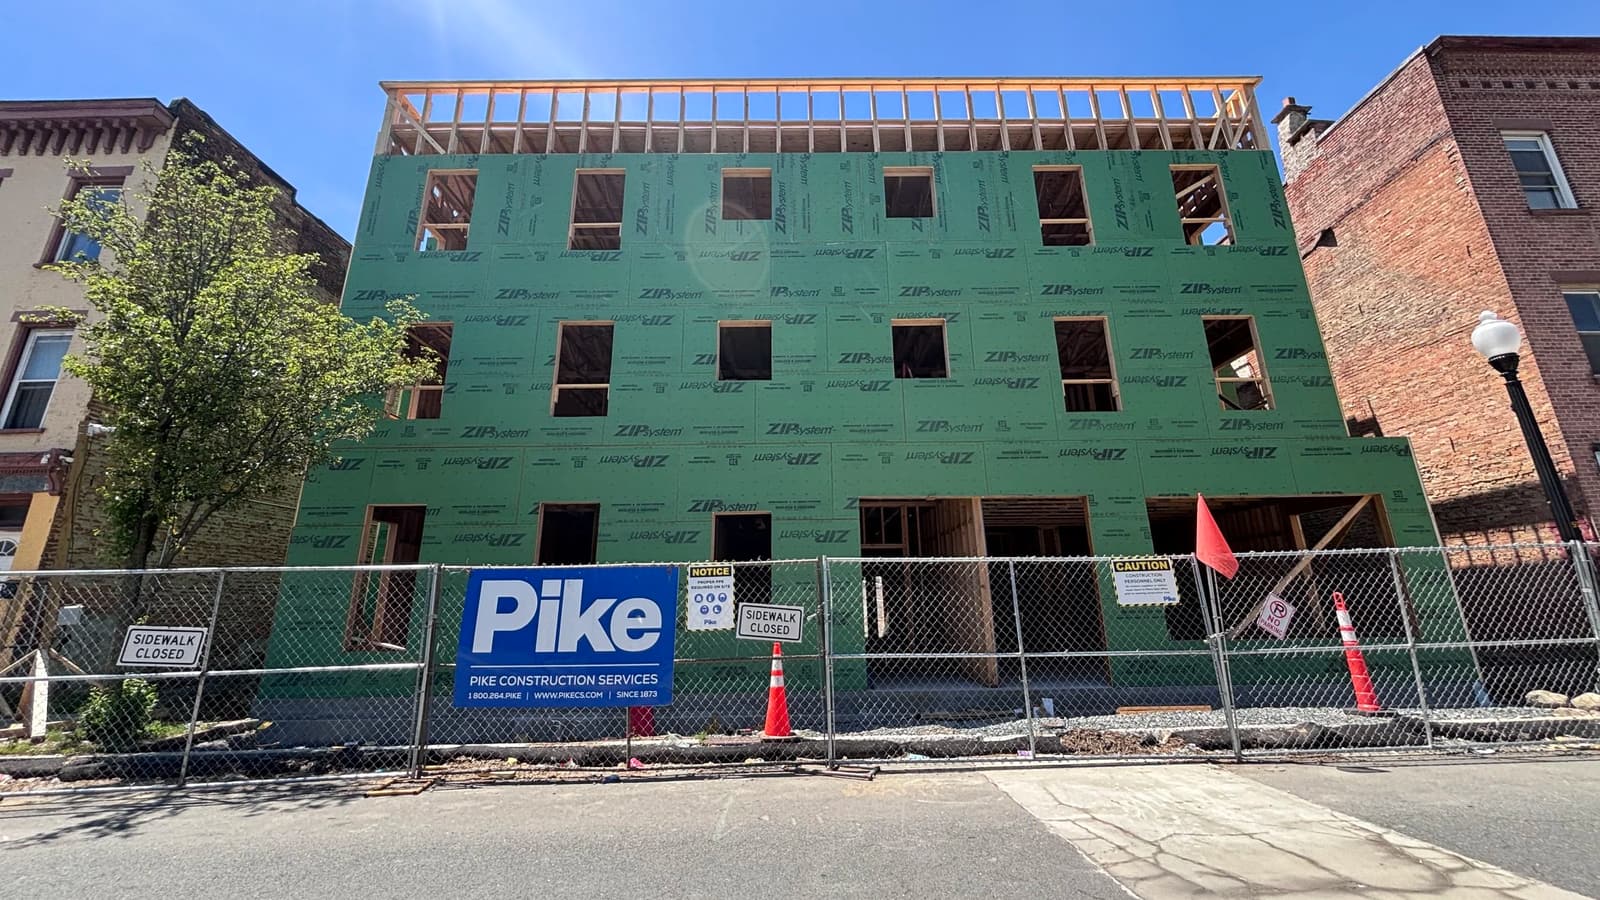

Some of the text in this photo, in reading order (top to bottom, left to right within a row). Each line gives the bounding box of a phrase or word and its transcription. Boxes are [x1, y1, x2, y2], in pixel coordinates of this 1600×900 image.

[692, 567, 730, 576] NOTICE
[1116, 561, 1169, 571] CAUTION
[472, 579, 662, 653] Pike
[746, 610, 796, 623] SIDEWALK
[1267, 615, 1280, 626] NO
[750, 623, 790, 635] CLOSED
[133, 634, 196, 646] SIDEWALK
[135, 648, 185, 659] CLOSED
[470, 674, 658, 686] PIKE CONSTRUCTION SERVICES
[534, 691, 603, 699] WWW.PIKECS.COM
[640, 690, 658, 698] 1873
